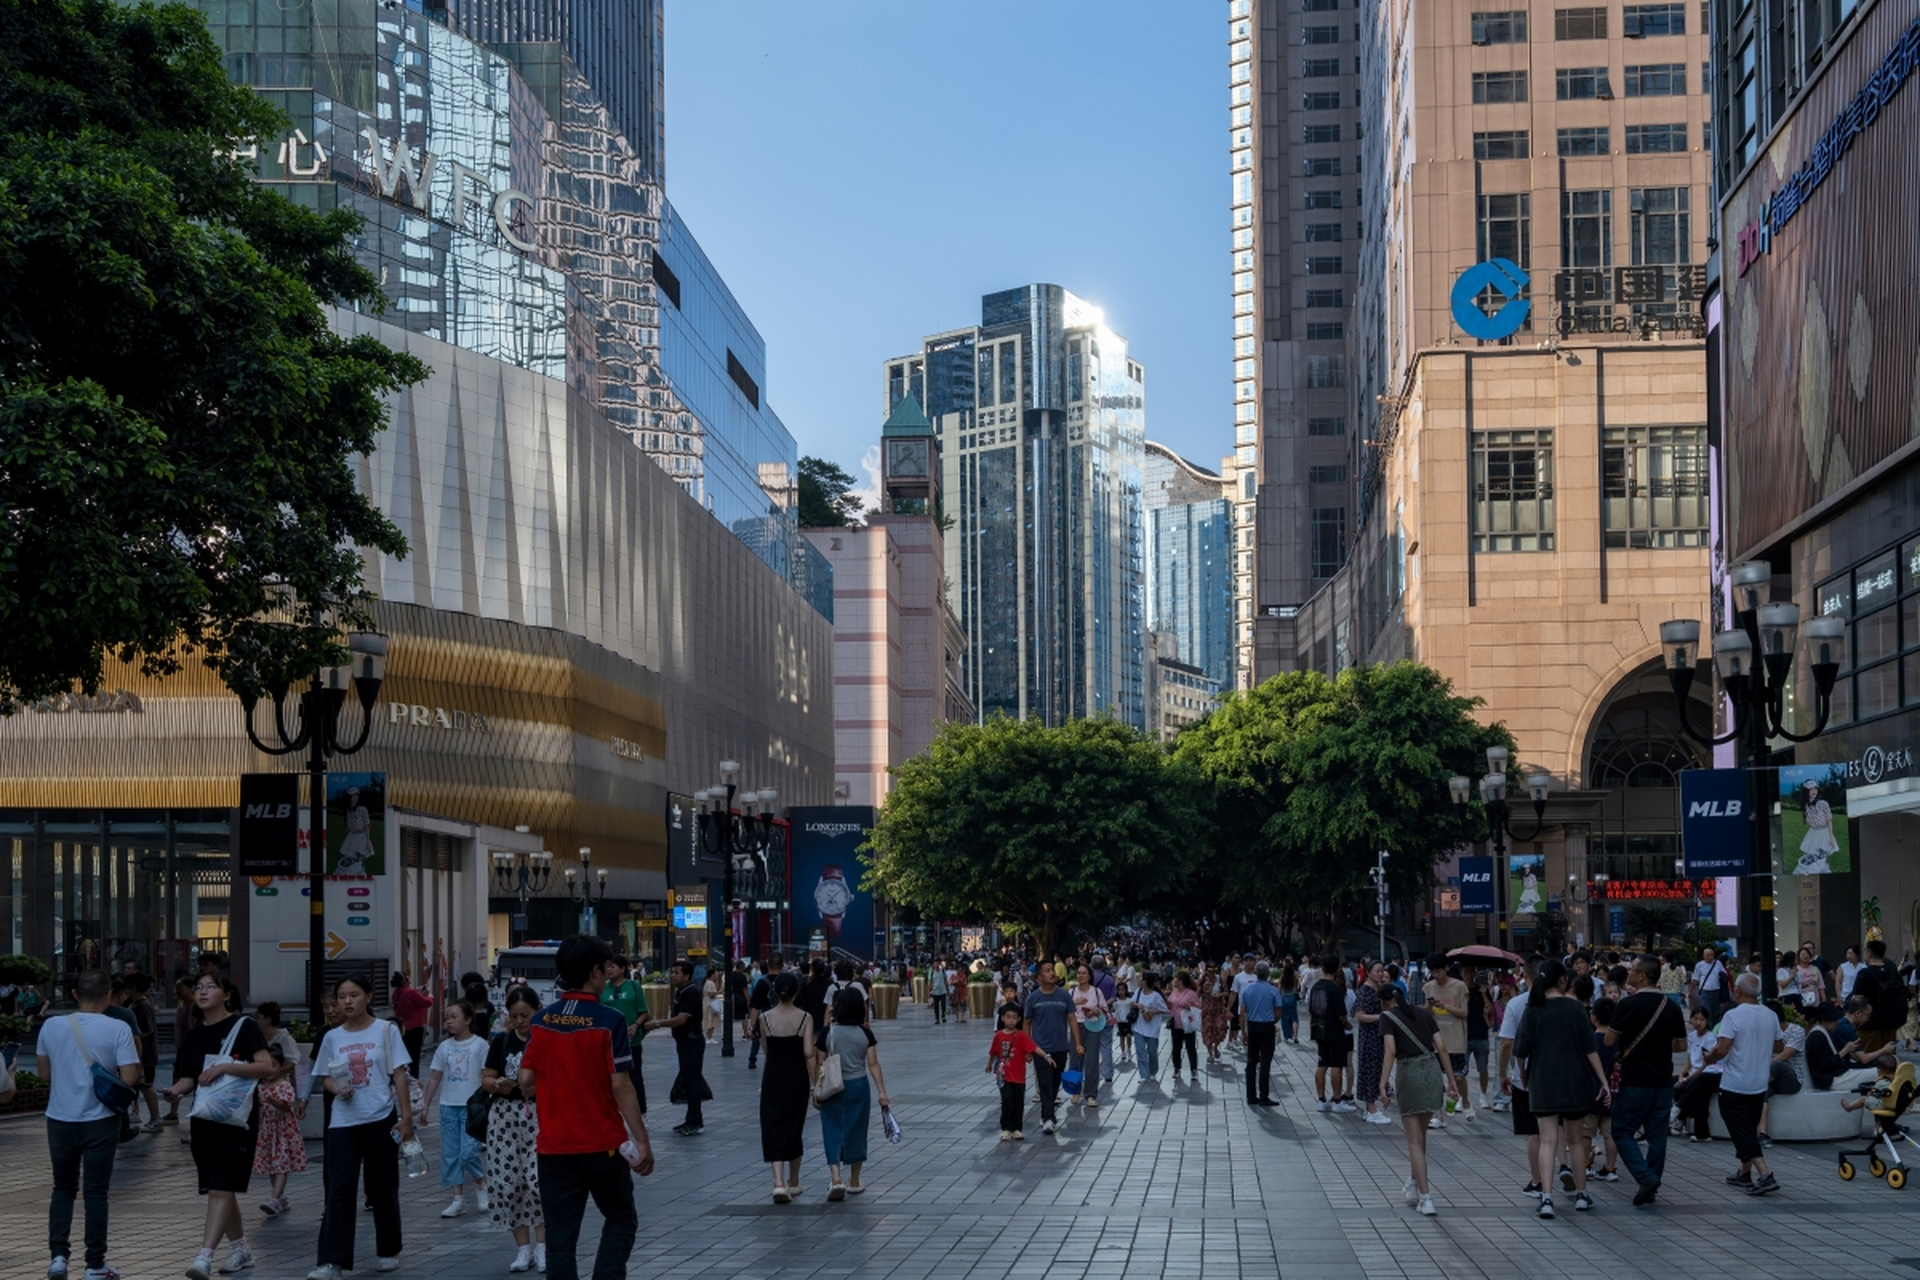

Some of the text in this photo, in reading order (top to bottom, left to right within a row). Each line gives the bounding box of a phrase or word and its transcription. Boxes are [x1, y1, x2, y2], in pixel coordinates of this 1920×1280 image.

[364, 123, 538, 252] WFC
[1556, 313, 1631, 333] China
[388, 701, 490, 732] PRADA
[244, 802, 292, 819] MLB
[1688, 799, 1743, 818] MLB
[805, 823, 861, 832] LONGINES
[1462, 872, 1491, 883] MLB
[551, 1014, 594, 1027] SHERPA'S
